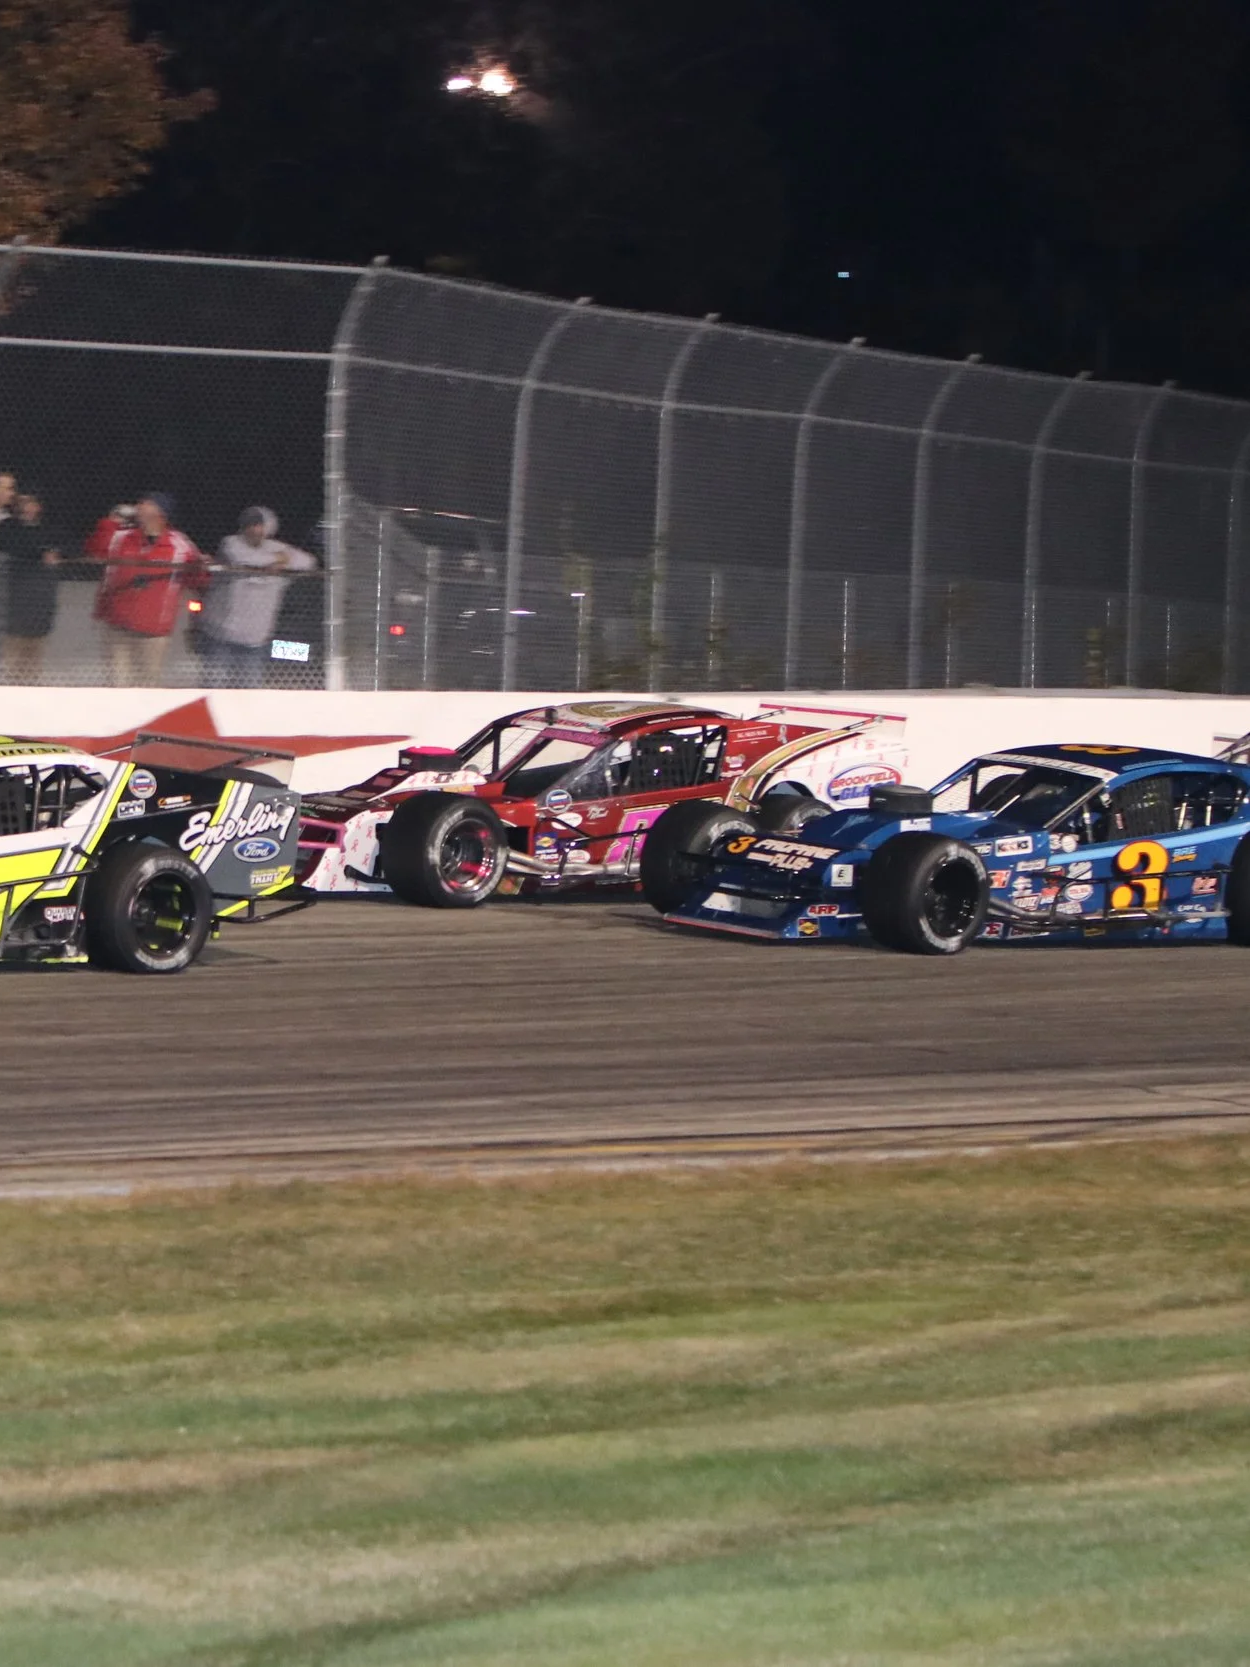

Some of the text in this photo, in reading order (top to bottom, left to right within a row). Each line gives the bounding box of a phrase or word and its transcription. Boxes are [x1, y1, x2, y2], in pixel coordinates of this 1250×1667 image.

[831, 771, 897, 788] BROOKFIELD
[179, 803, 296, 851] Emerling
[243, 842, 270, 857] Ford
[727, 836, 757, 853] 3
[1111, 840, 1169, 910] 3
[809, 905, 838, 914] ARP
